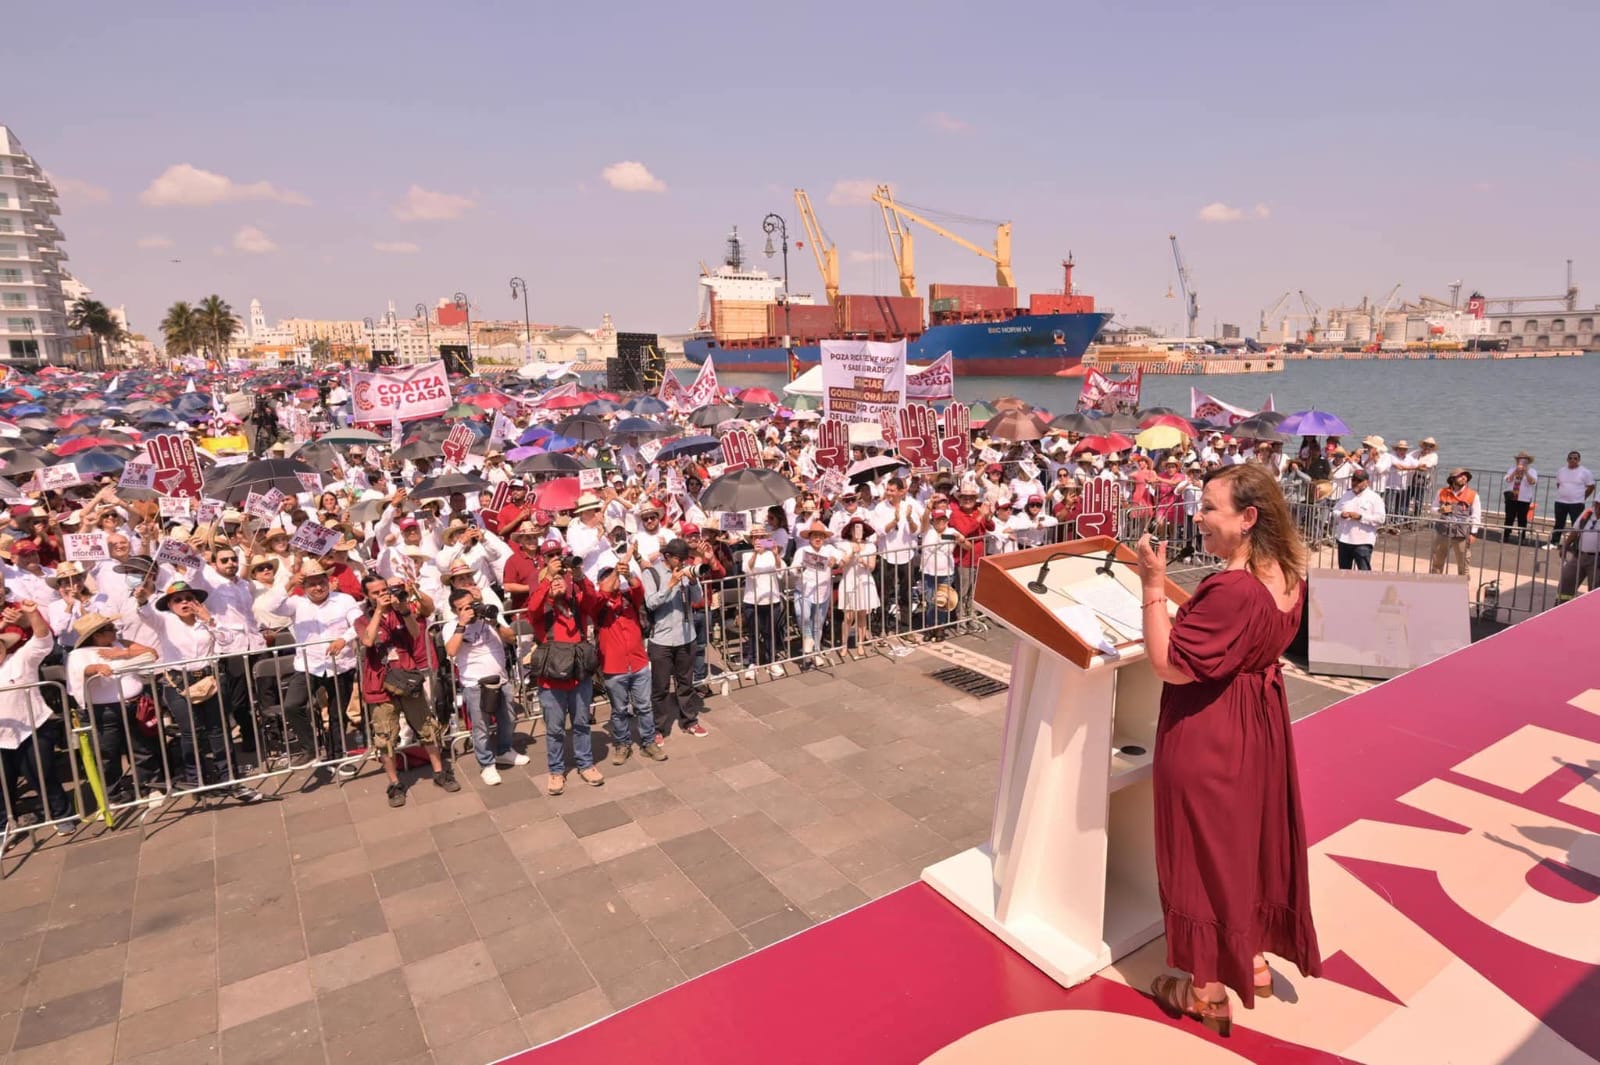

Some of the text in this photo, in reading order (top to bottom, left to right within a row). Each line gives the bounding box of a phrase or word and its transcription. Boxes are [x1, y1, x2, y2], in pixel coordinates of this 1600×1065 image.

[830, 352, 850, 361] POZA
[377, 375, 444, 396] COATZA
[405, 387, 446, 404] CASA
[926, 410, 939, 455] POZA RICA
[183, 440, 201, 484] POZA RICA
[72, 548, 105, 557] morena
[159, 551, 201, 569] morena
